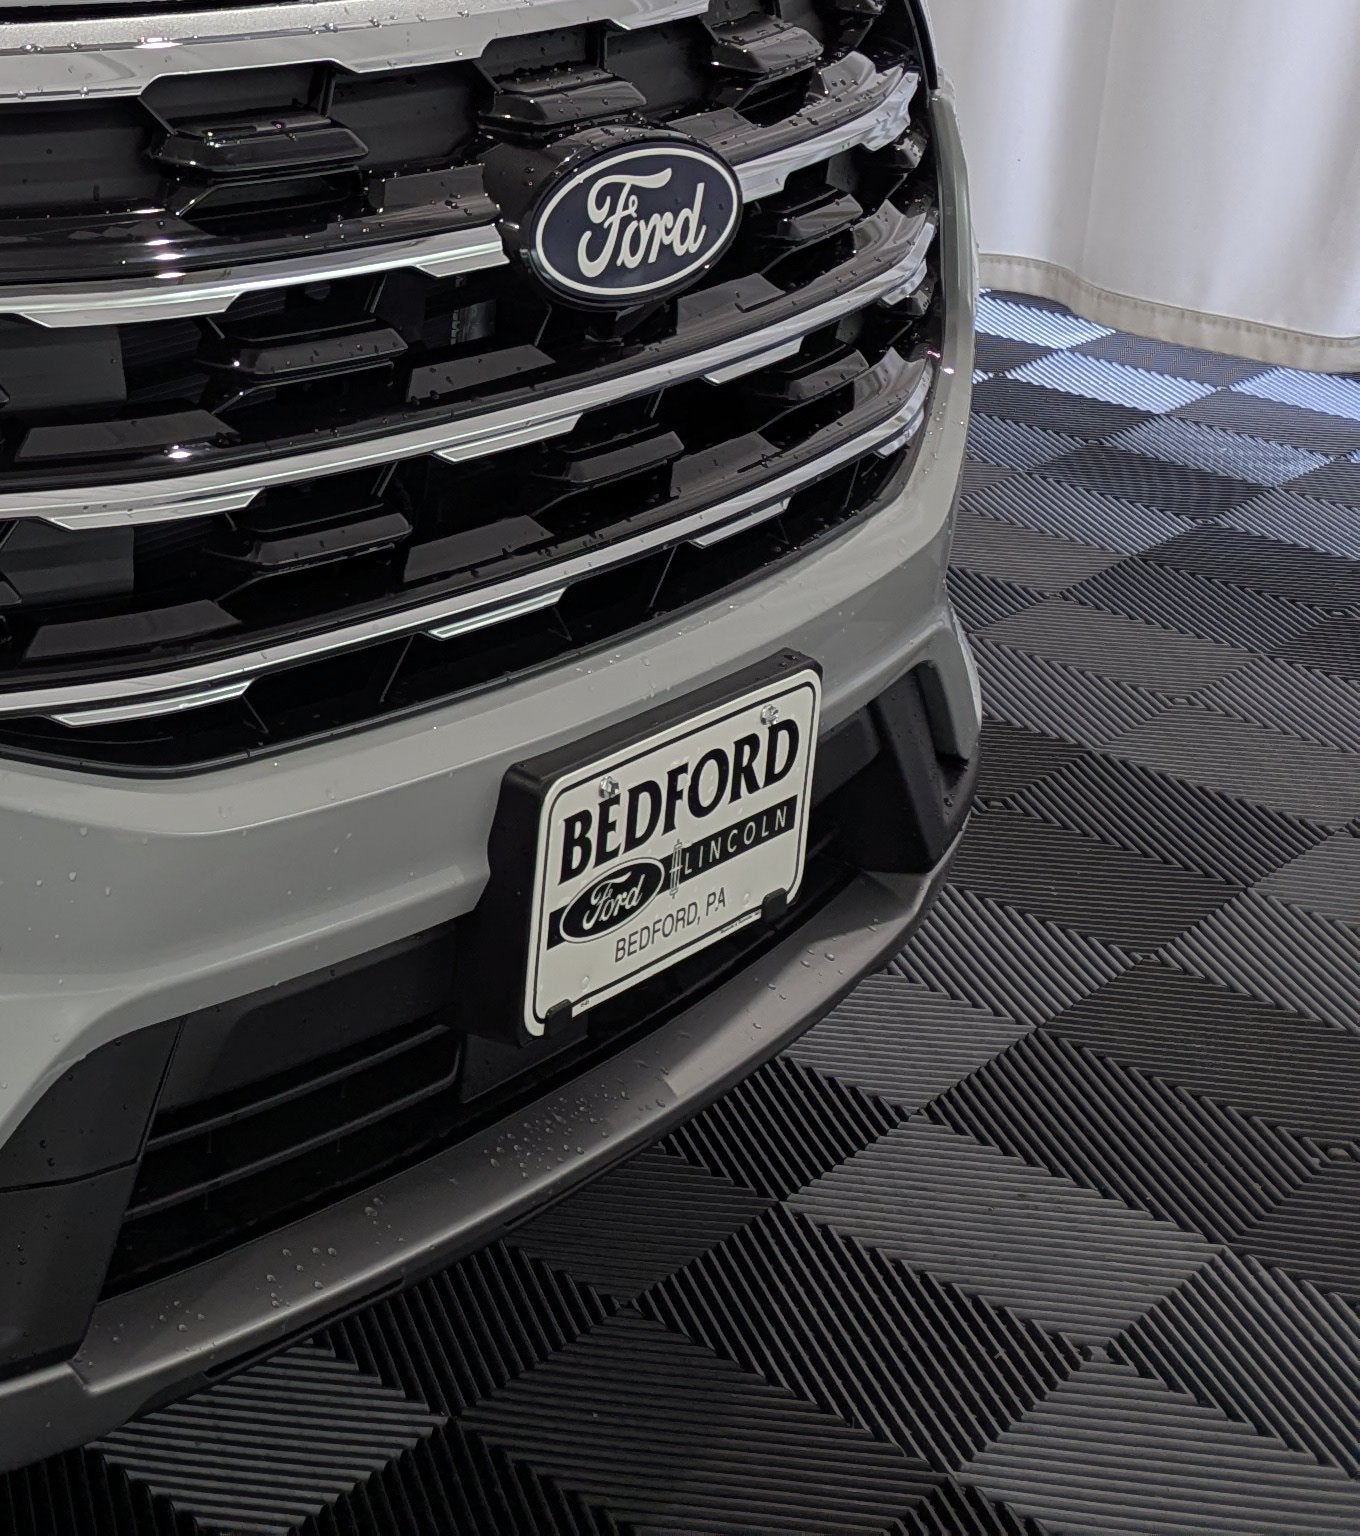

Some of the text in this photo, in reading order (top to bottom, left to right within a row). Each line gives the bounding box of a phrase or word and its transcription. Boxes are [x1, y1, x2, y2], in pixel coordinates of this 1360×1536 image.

[577, 167, 706, 277] Ford
[558, 719, 799, 885] BEDFORD
[685, 806, 788, 874] LINCOLN
[583, 871, 645, 931] Ford
[615, 902, 700, 963] BEDFORD,
[706, 887, 726, 917] PA
